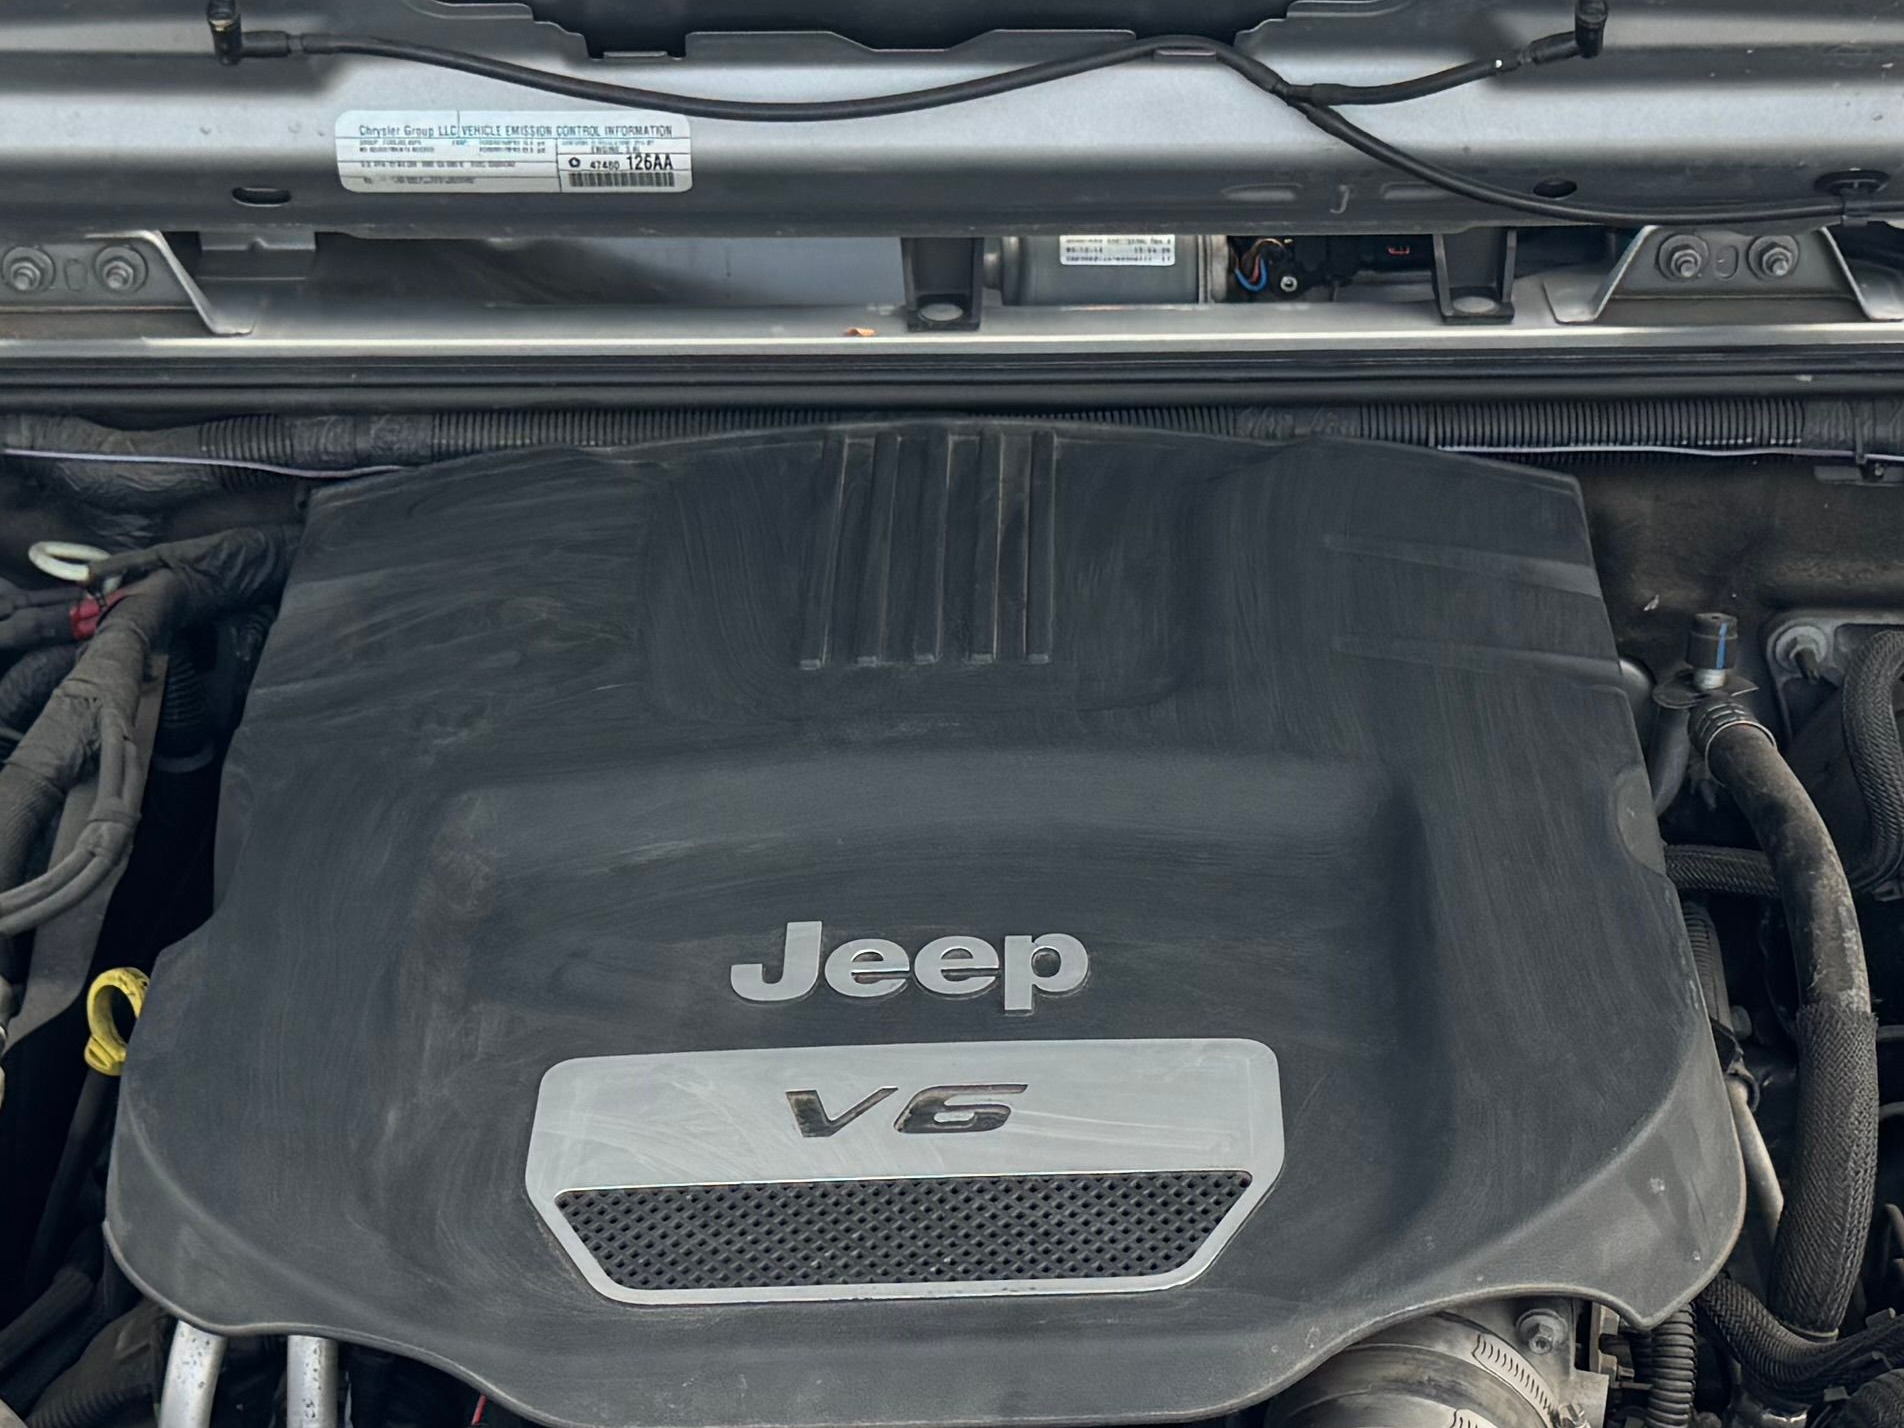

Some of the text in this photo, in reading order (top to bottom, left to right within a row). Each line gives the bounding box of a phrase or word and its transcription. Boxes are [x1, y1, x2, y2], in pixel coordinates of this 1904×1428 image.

[359, 125, 672, 138] Chrysler Group LLC VEHICLE EMISSION CONTROL INFORMATION
[627, 153, 673, 170] 126AA
[730, 921, 1090, 1012] Jeep
[785, 1084, 1030, 1138] V6
